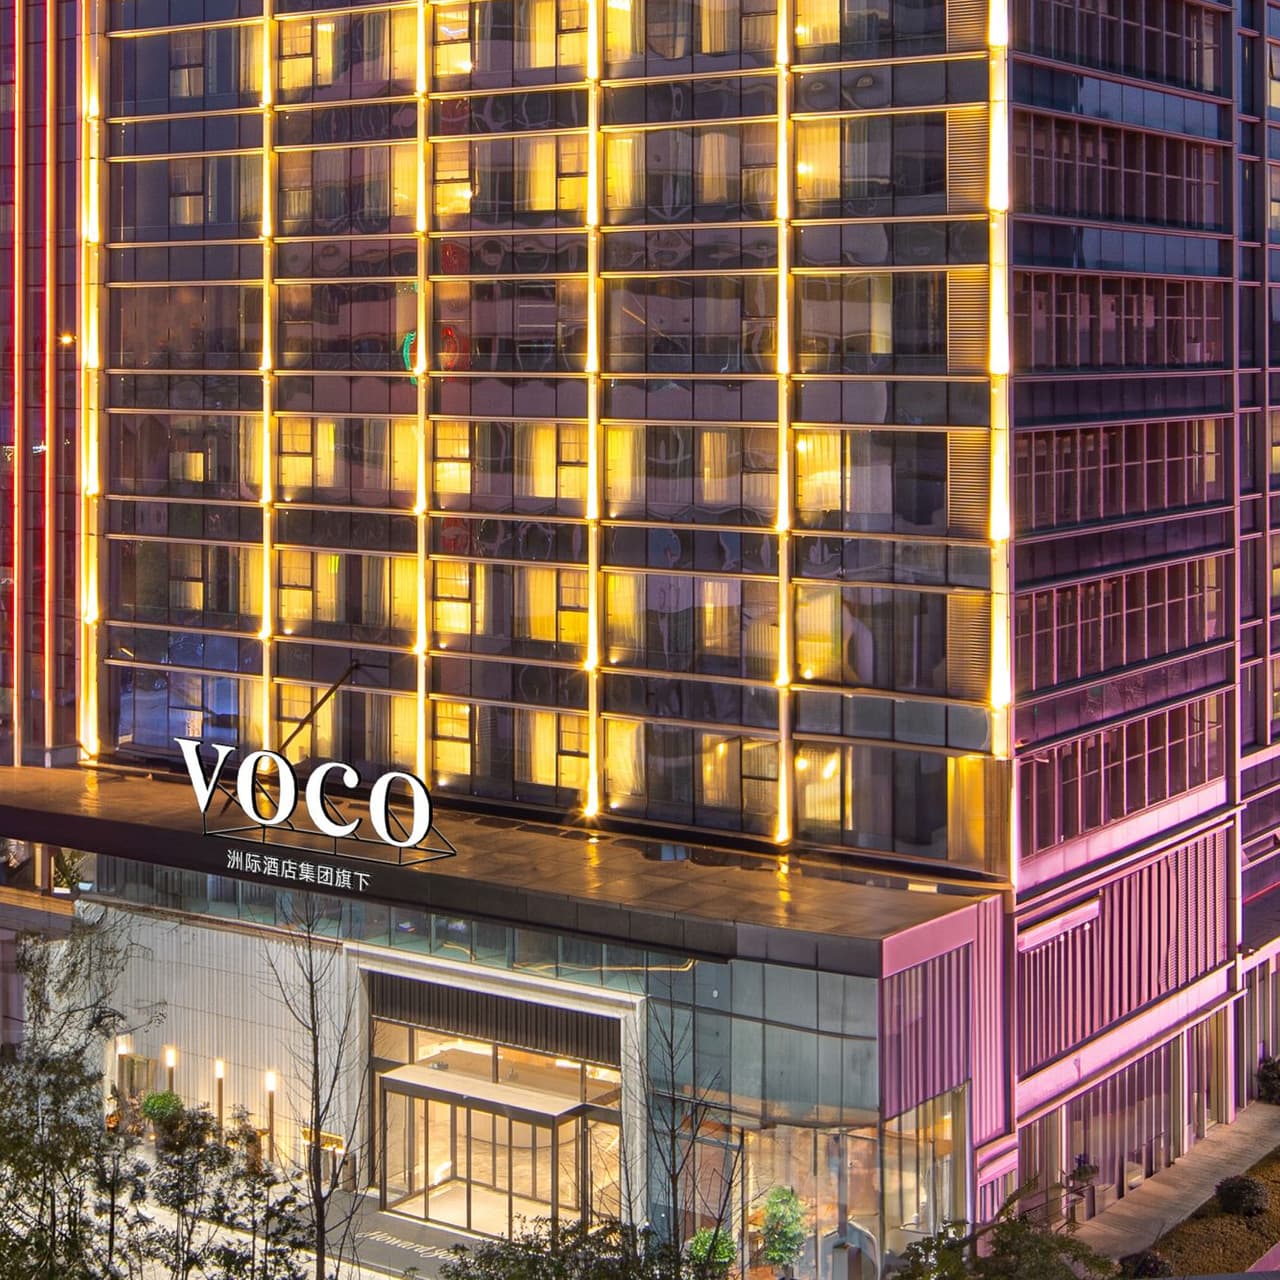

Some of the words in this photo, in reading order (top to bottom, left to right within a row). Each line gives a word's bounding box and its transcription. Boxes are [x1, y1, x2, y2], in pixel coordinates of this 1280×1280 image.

[226, 848, 371, 892] 洲际酒店集团旗下
